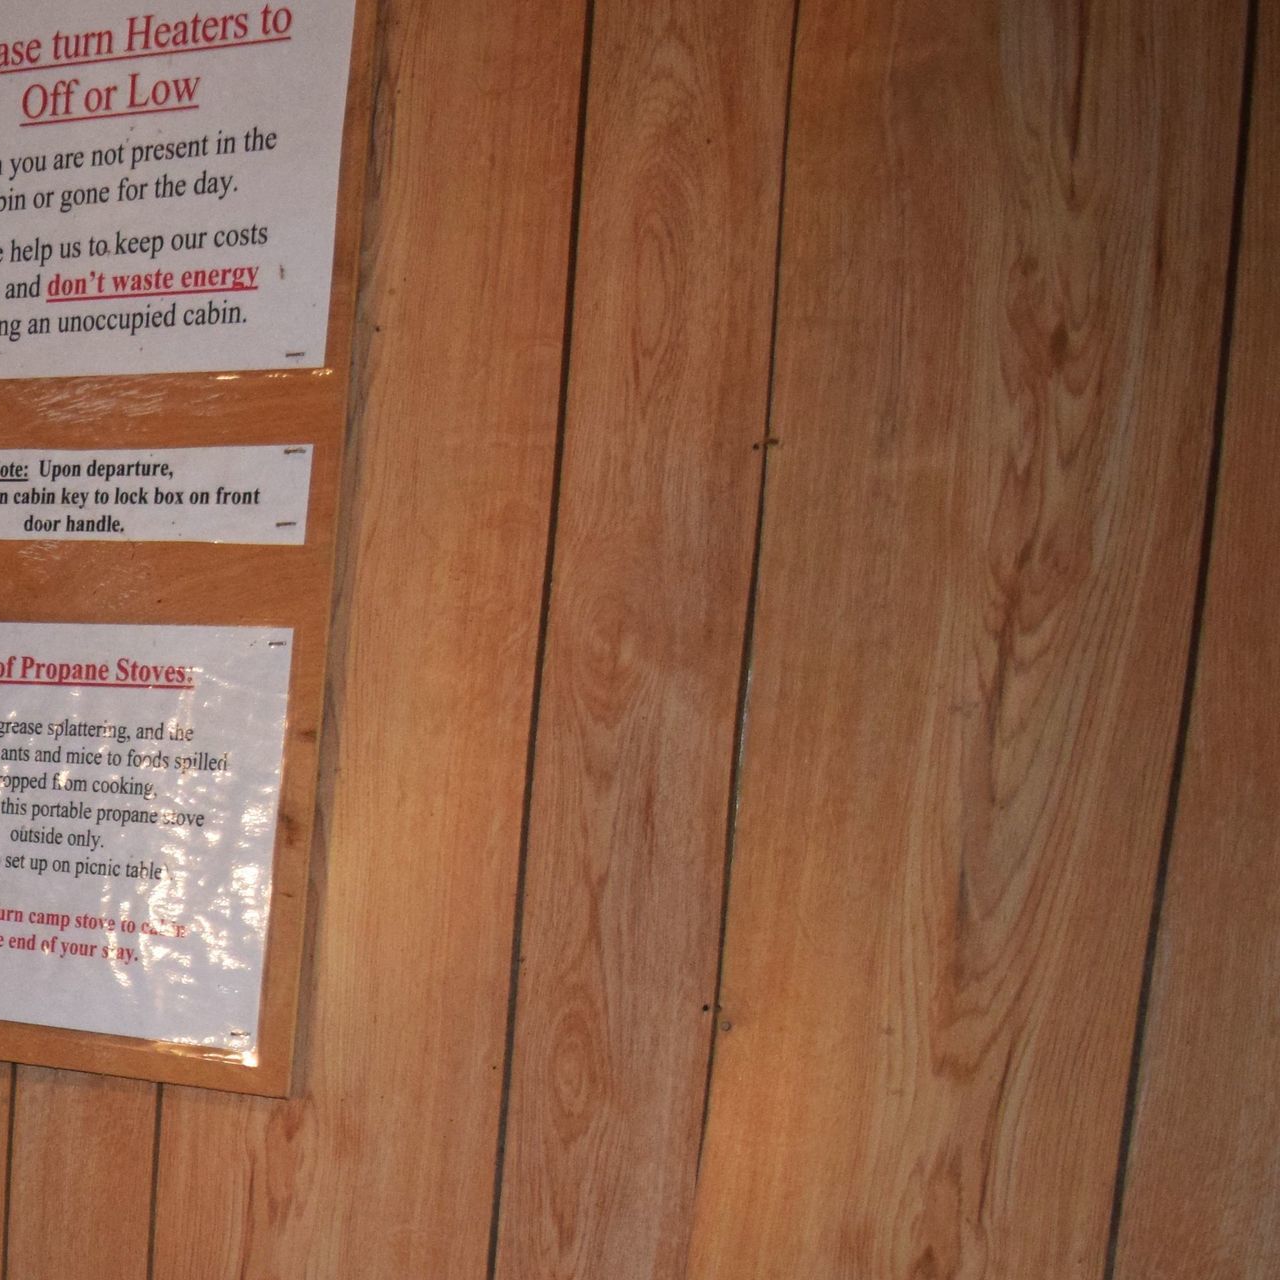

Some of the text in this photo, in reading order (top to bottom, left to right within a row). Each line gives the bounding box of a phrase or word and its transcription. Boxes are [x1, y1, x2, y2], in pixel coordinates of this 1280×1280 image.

[50, 28, 114, 62] turn
[122, 11, 249, 53] Heaters
[259, 2, 293, 37] to
[20, 71, 201, 121] Off or Low
[6, 153, 48, 182] you
[51, 149, 85, 171] are
[89, 142, 126, 168] not
[128, 133, 209, 171] present
[214, 128, 237, 156] in
[242, 124, 278, 153] the
[31, 189, 56, 210] or
[58, 184, 111, 214] gone
[115, 175, 150, 203] for
[153, 171, 187, 200] the
[191, 168, 239, 201] day.
[37, 457, 82, 483] Upon
[84, 457, 174, 483] departure,
[11, 485, 57, 506] cabin
[58, 485, 90, 510] key
[92, 487, 110, 506] to
[112, 485, 149, 506] lock
[152, 485, 185, 506] box
[187, 489, 211, 506] on
[214, 484, 262, 506] front
[21, 512, 125, 534] door handle.
[18, 654, 110, 687] Propane
[114, 656, 194, 685] Stoves:
